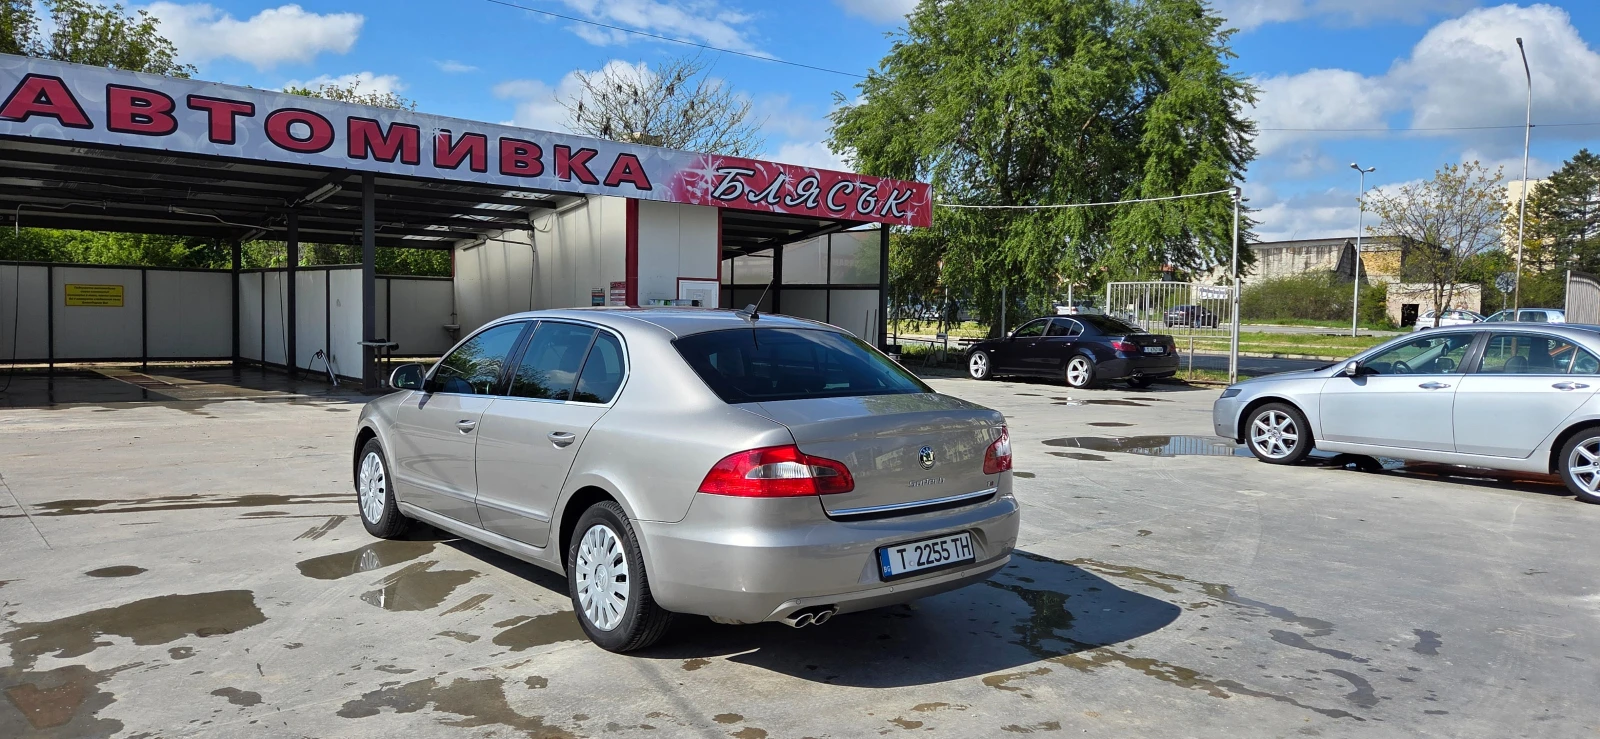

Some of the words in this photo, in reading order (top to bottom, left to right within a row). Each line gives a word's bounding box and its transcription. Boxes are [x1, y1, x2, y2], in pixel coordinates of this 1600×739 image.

[0, 72, 653, 190] АВТОМИВКА
[711, 165, 913, 218] БЛЯСЪК
[896, 548, 907, 570] T
[914, 540, 951, 567] 2255
[951, 536, 972, 559] TH
